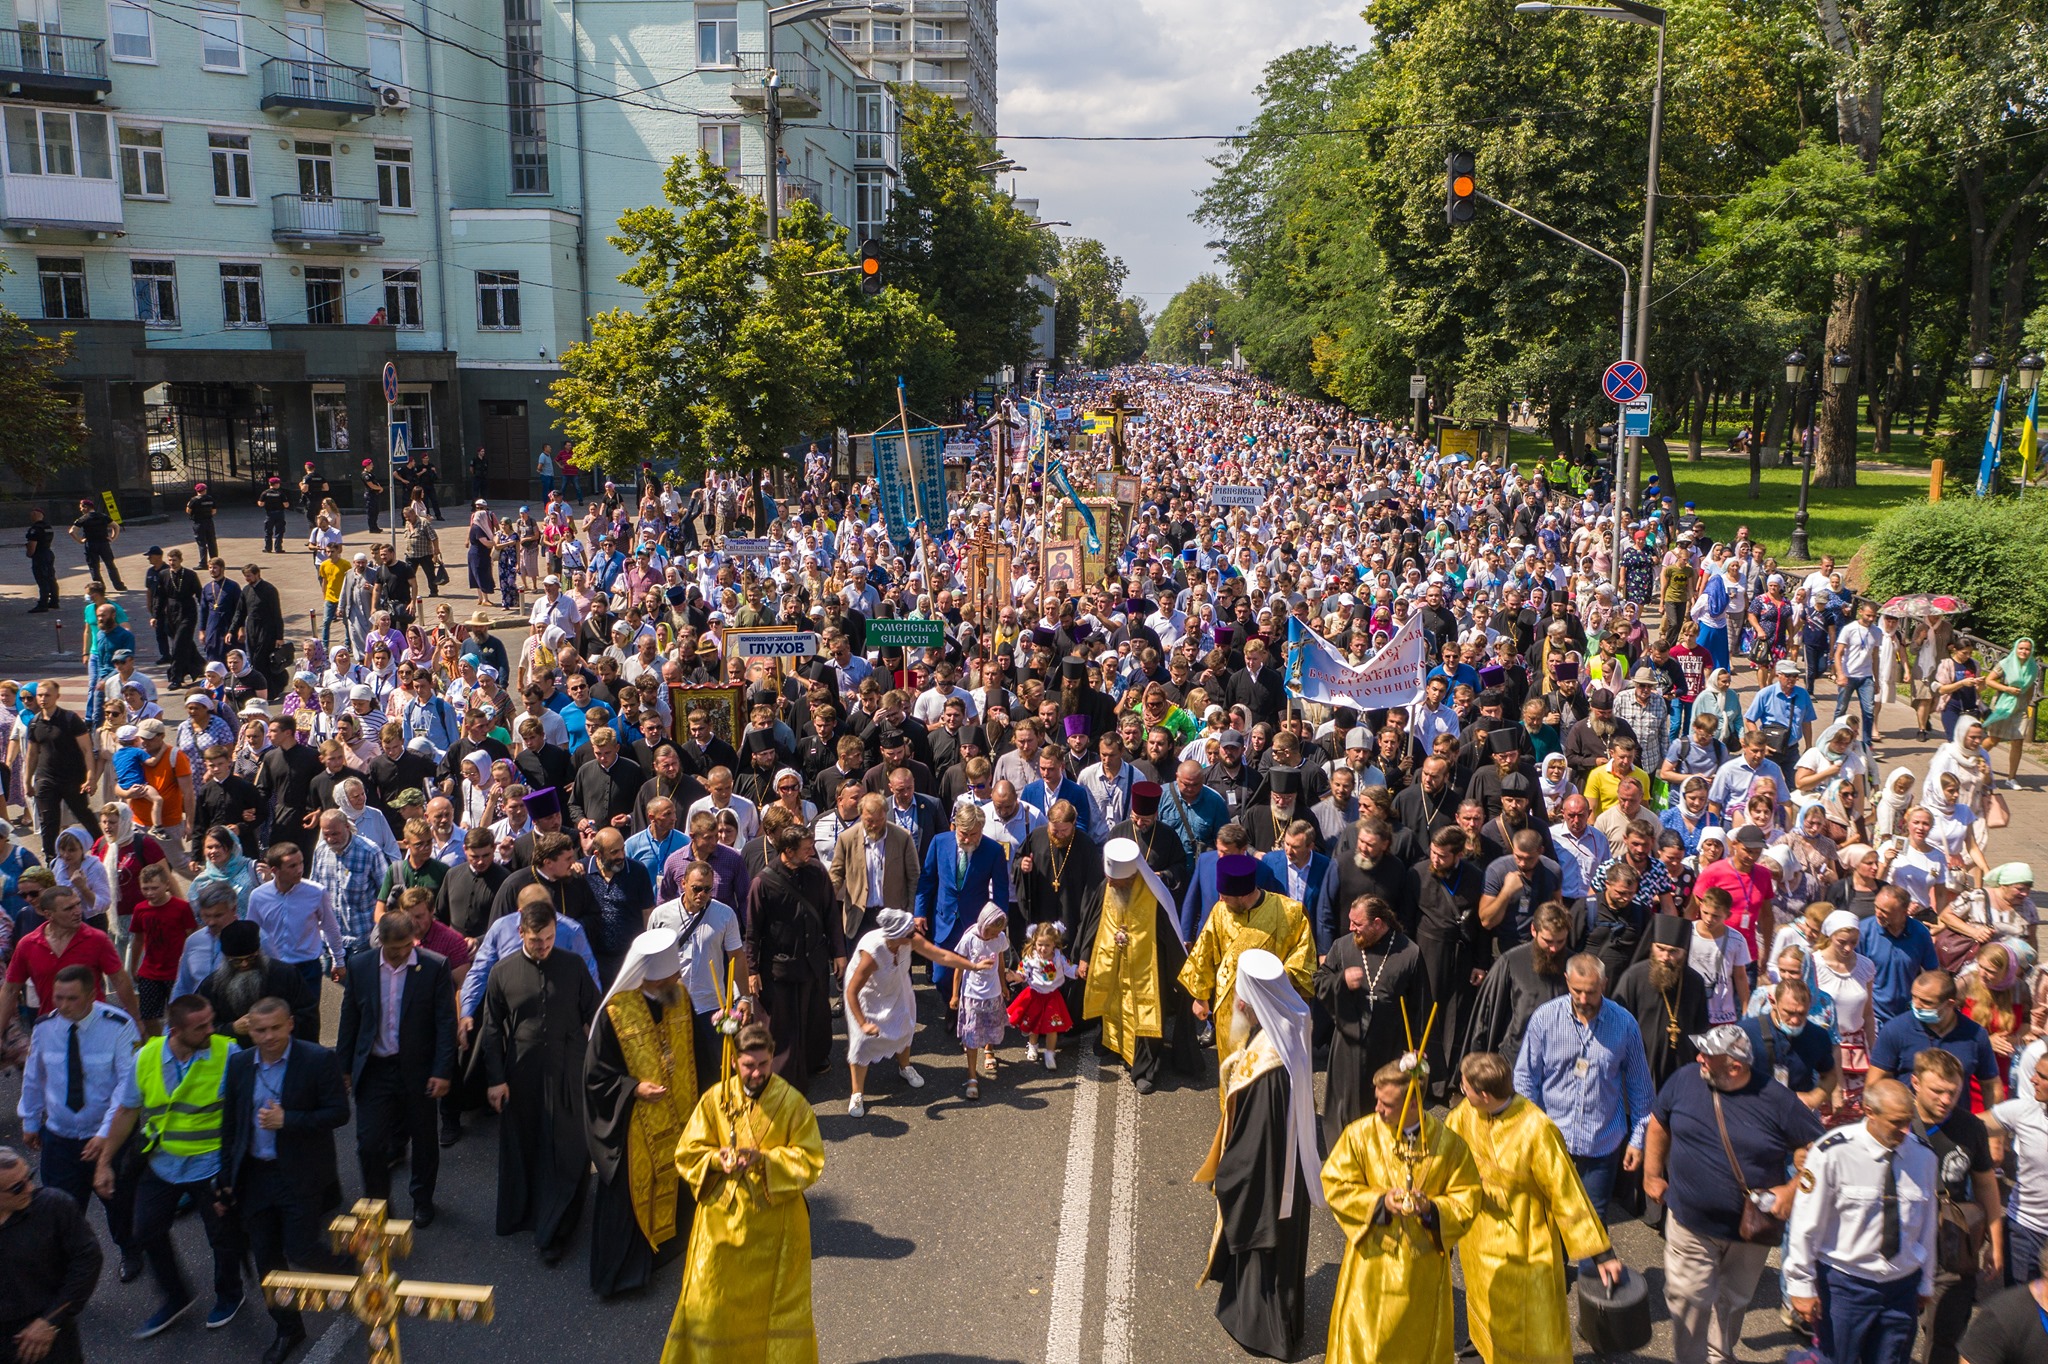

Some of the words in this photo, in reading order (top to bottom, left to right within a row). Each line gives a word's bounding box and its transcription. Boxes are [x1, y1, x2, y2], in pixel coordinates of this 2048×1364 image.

[871, 623, 939, 632] РОМЕНСЬКА
[881, 634, 929, 644] ЄПАРХІЯ
[749, 642, 805, 654] ГЛУХОВ
